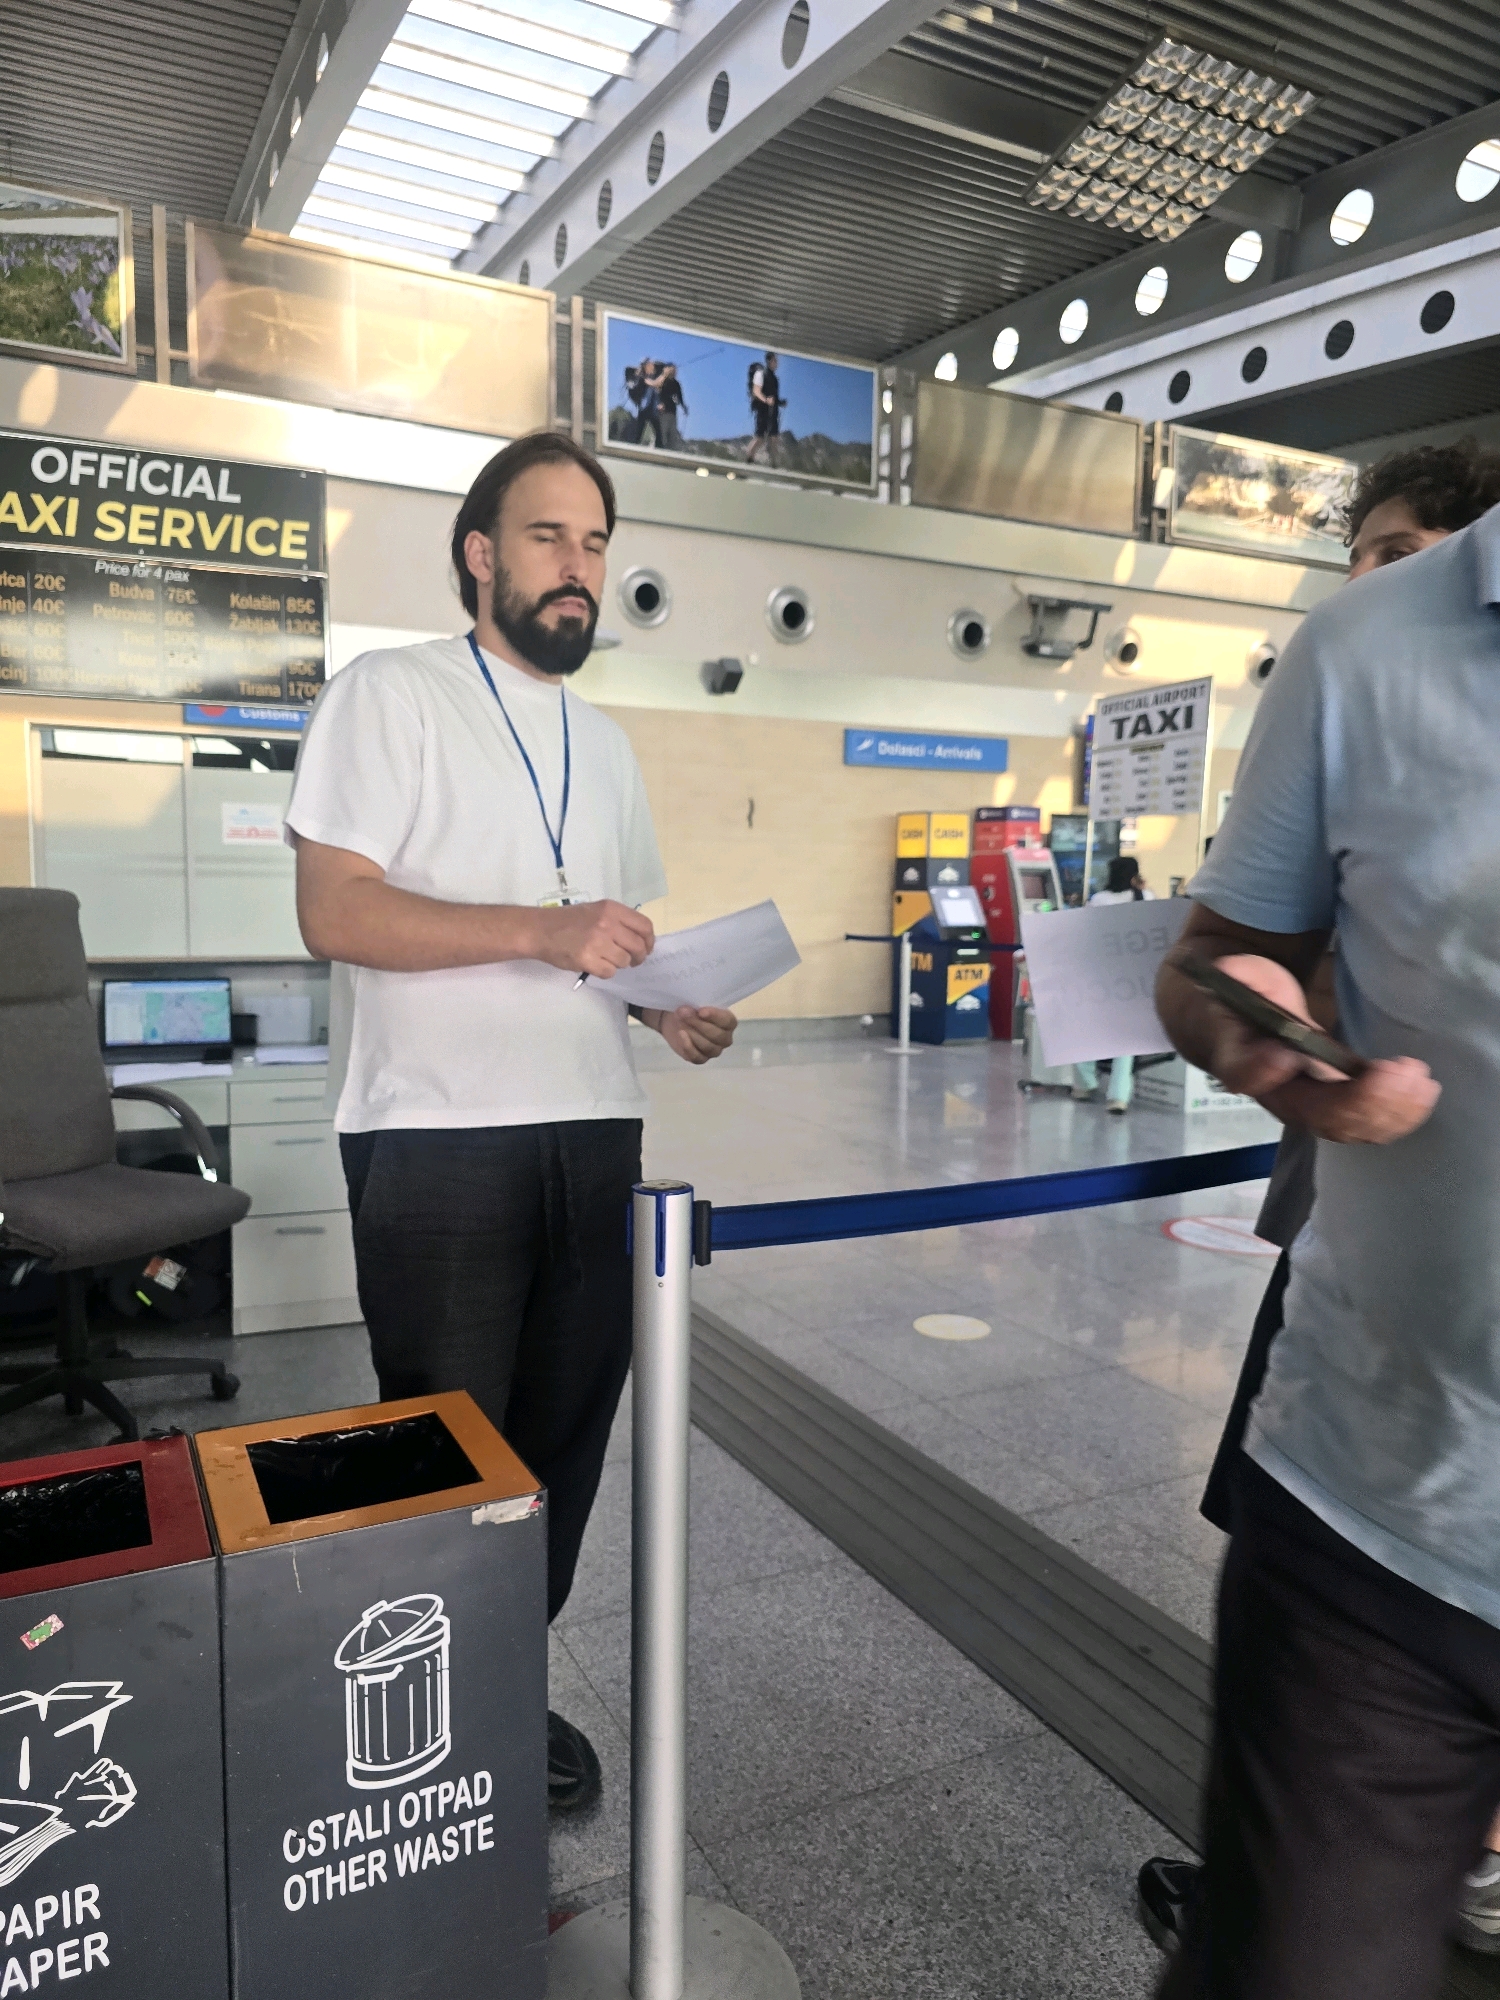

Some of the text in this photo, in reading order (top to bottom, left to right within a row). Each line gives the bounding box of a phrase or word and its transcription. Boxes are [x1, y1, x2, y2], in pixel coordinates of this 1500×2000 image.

[31, 446, 242, 504] OFFICIAL
[0, 490, 311, 560] AXI SERVICE
[0, 570, 66, 592] rica 20€
[94, 559, 190, 583] Price for 4 pax
[32, 597, 66, 616] 40€
[1110, 704, 1194, 740] TAXI
[910, 951, 984, 981] TM ATM
[282, 1770, 493, 1864] OSTALI OTPAD
[283, 1813, 495, 1912] OTHER WASTE
[0, 1883, 101, 1946] APIR
[0, 1931, 110, 1999] APER
